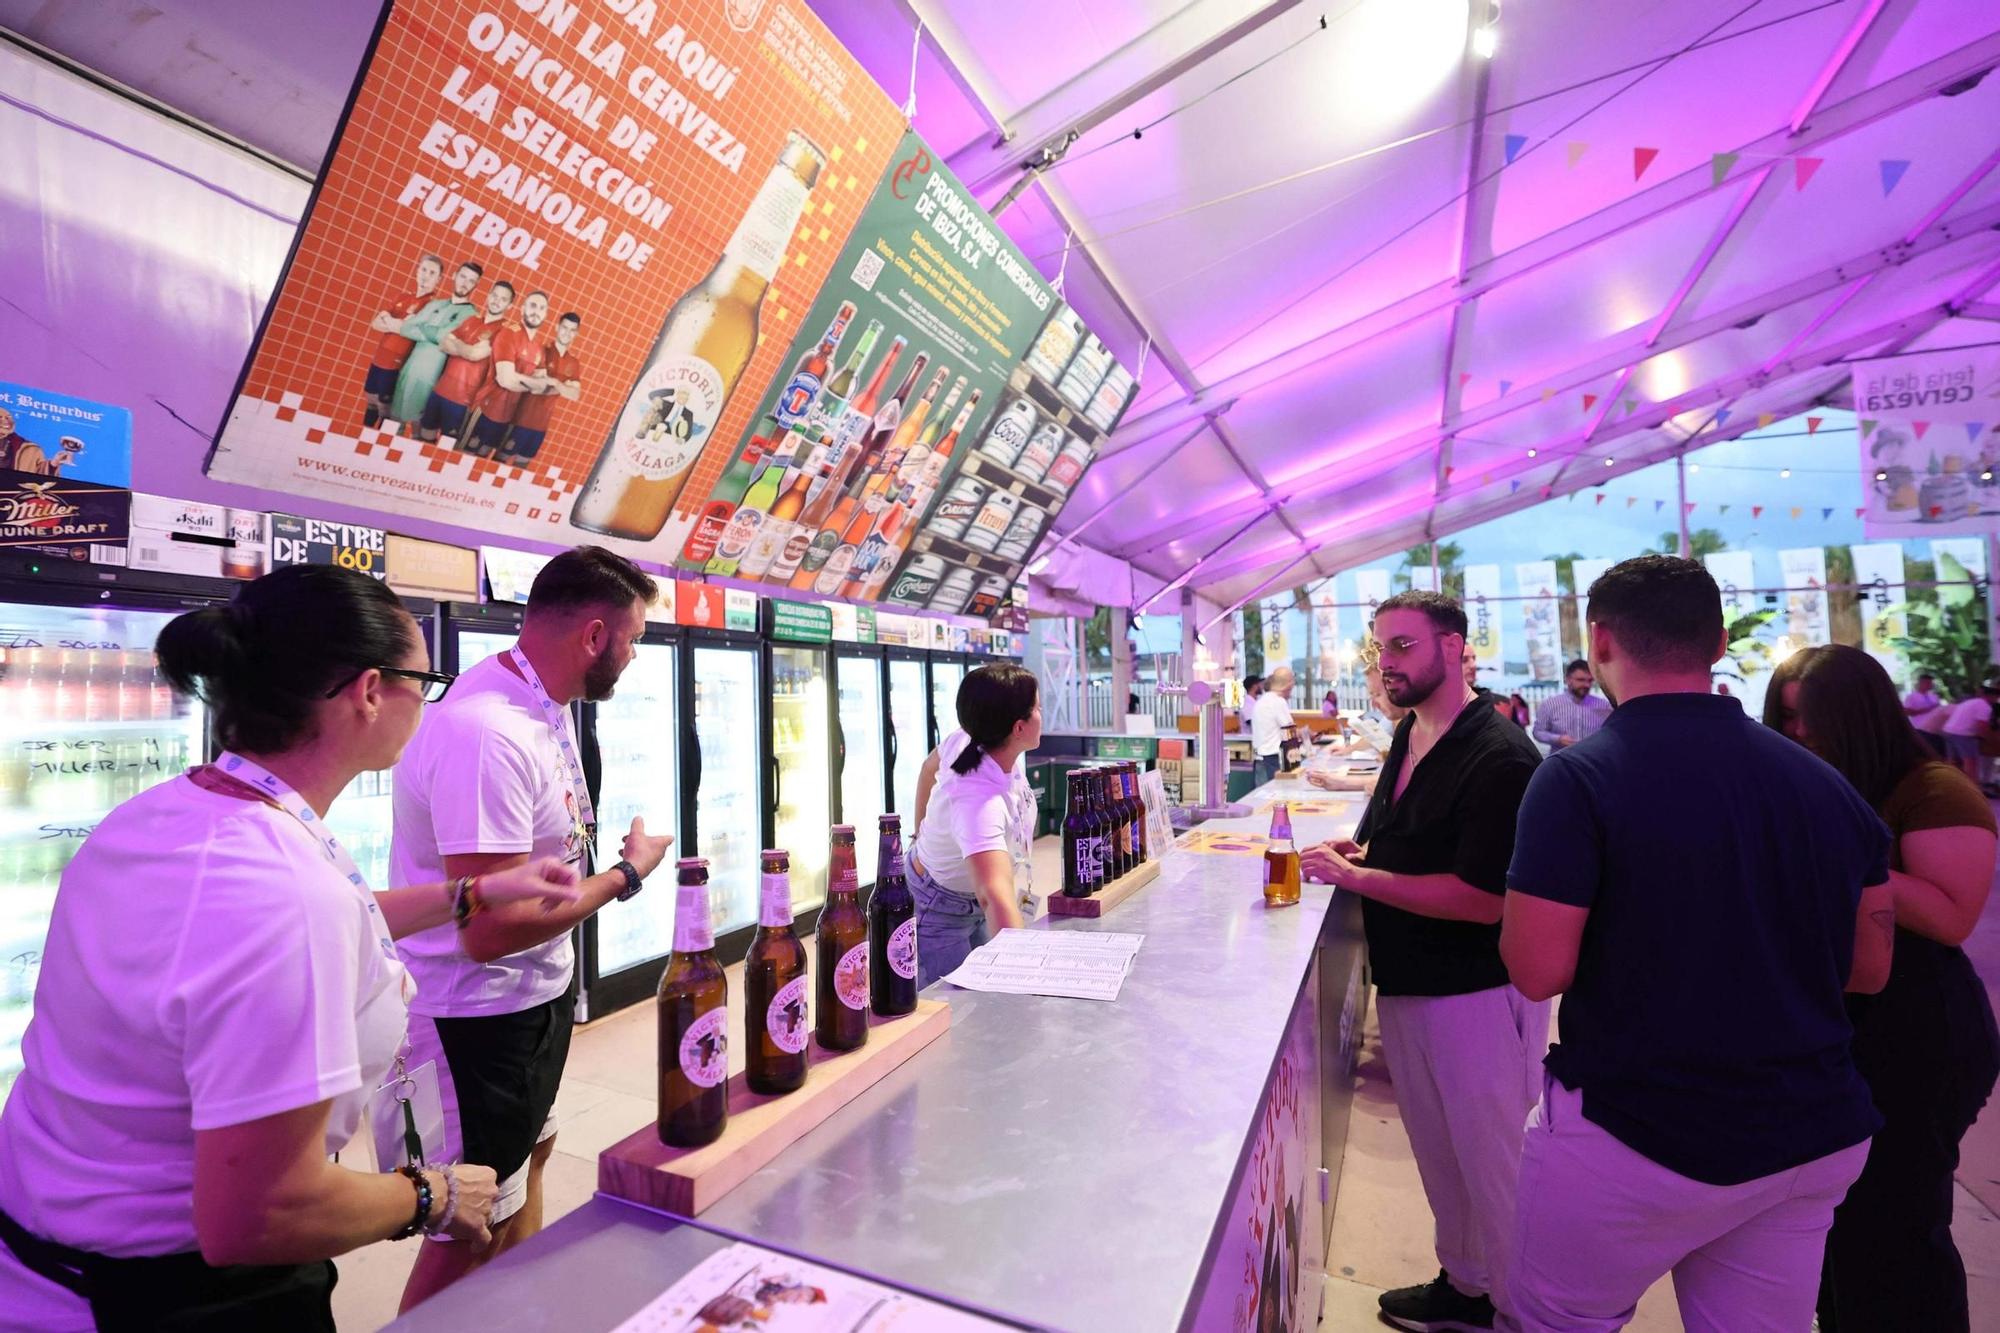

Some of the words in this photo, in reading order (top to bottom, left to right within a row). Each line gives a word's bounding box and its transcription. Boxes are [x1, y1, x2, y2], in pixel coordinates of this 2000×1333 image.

[653, 24, 740, 100] AQUÍ
[467, 12, 608, 132] OFICIAL
[607, 114, 658, 163] DE
[575, 22, 626, 81] LA
[628, 65, 748, 174] CERVEZA
[440, 64, 500, 125] LA
[500, 105, 673, 230] SELECCIÓN
[418, 119, 609, 249] ESPAÑOLA
[607, 231, 655, 272] DE
[400, 172, 547, 271] FÚTBOL
[914, 192, 937, 222] DE
[932, 209, 961, 254] IBIZA,
[961, 240, 981, 271] S.A.
[926, 171, 1000, 257] PROMOCIONES
[996, 248, 1051, 312] COMERCIALES
[648, 367, 716, 411] VICTORIA
[17, 393, 104, 422] Bernardus
[29, 411, 48, 420] ABT
[626, 440, 686, 469] MÁLAGA
[297, 455, 496, 509] www.cervezavictoria.es
[0, 498, 80, 521] Miller
[176, 513, 214, 527] Asahi
[0, 526, 47, 537] UINE
[52, 523, 109, 535] DRAFT
[226, 526, 264, 543] Asahi
[305, 518, 385, 551] ESTRE
[273, 536, 308, 564] DE
[338, 545, 373, 572] 60
[31, 760, 116, 774] MILLER
